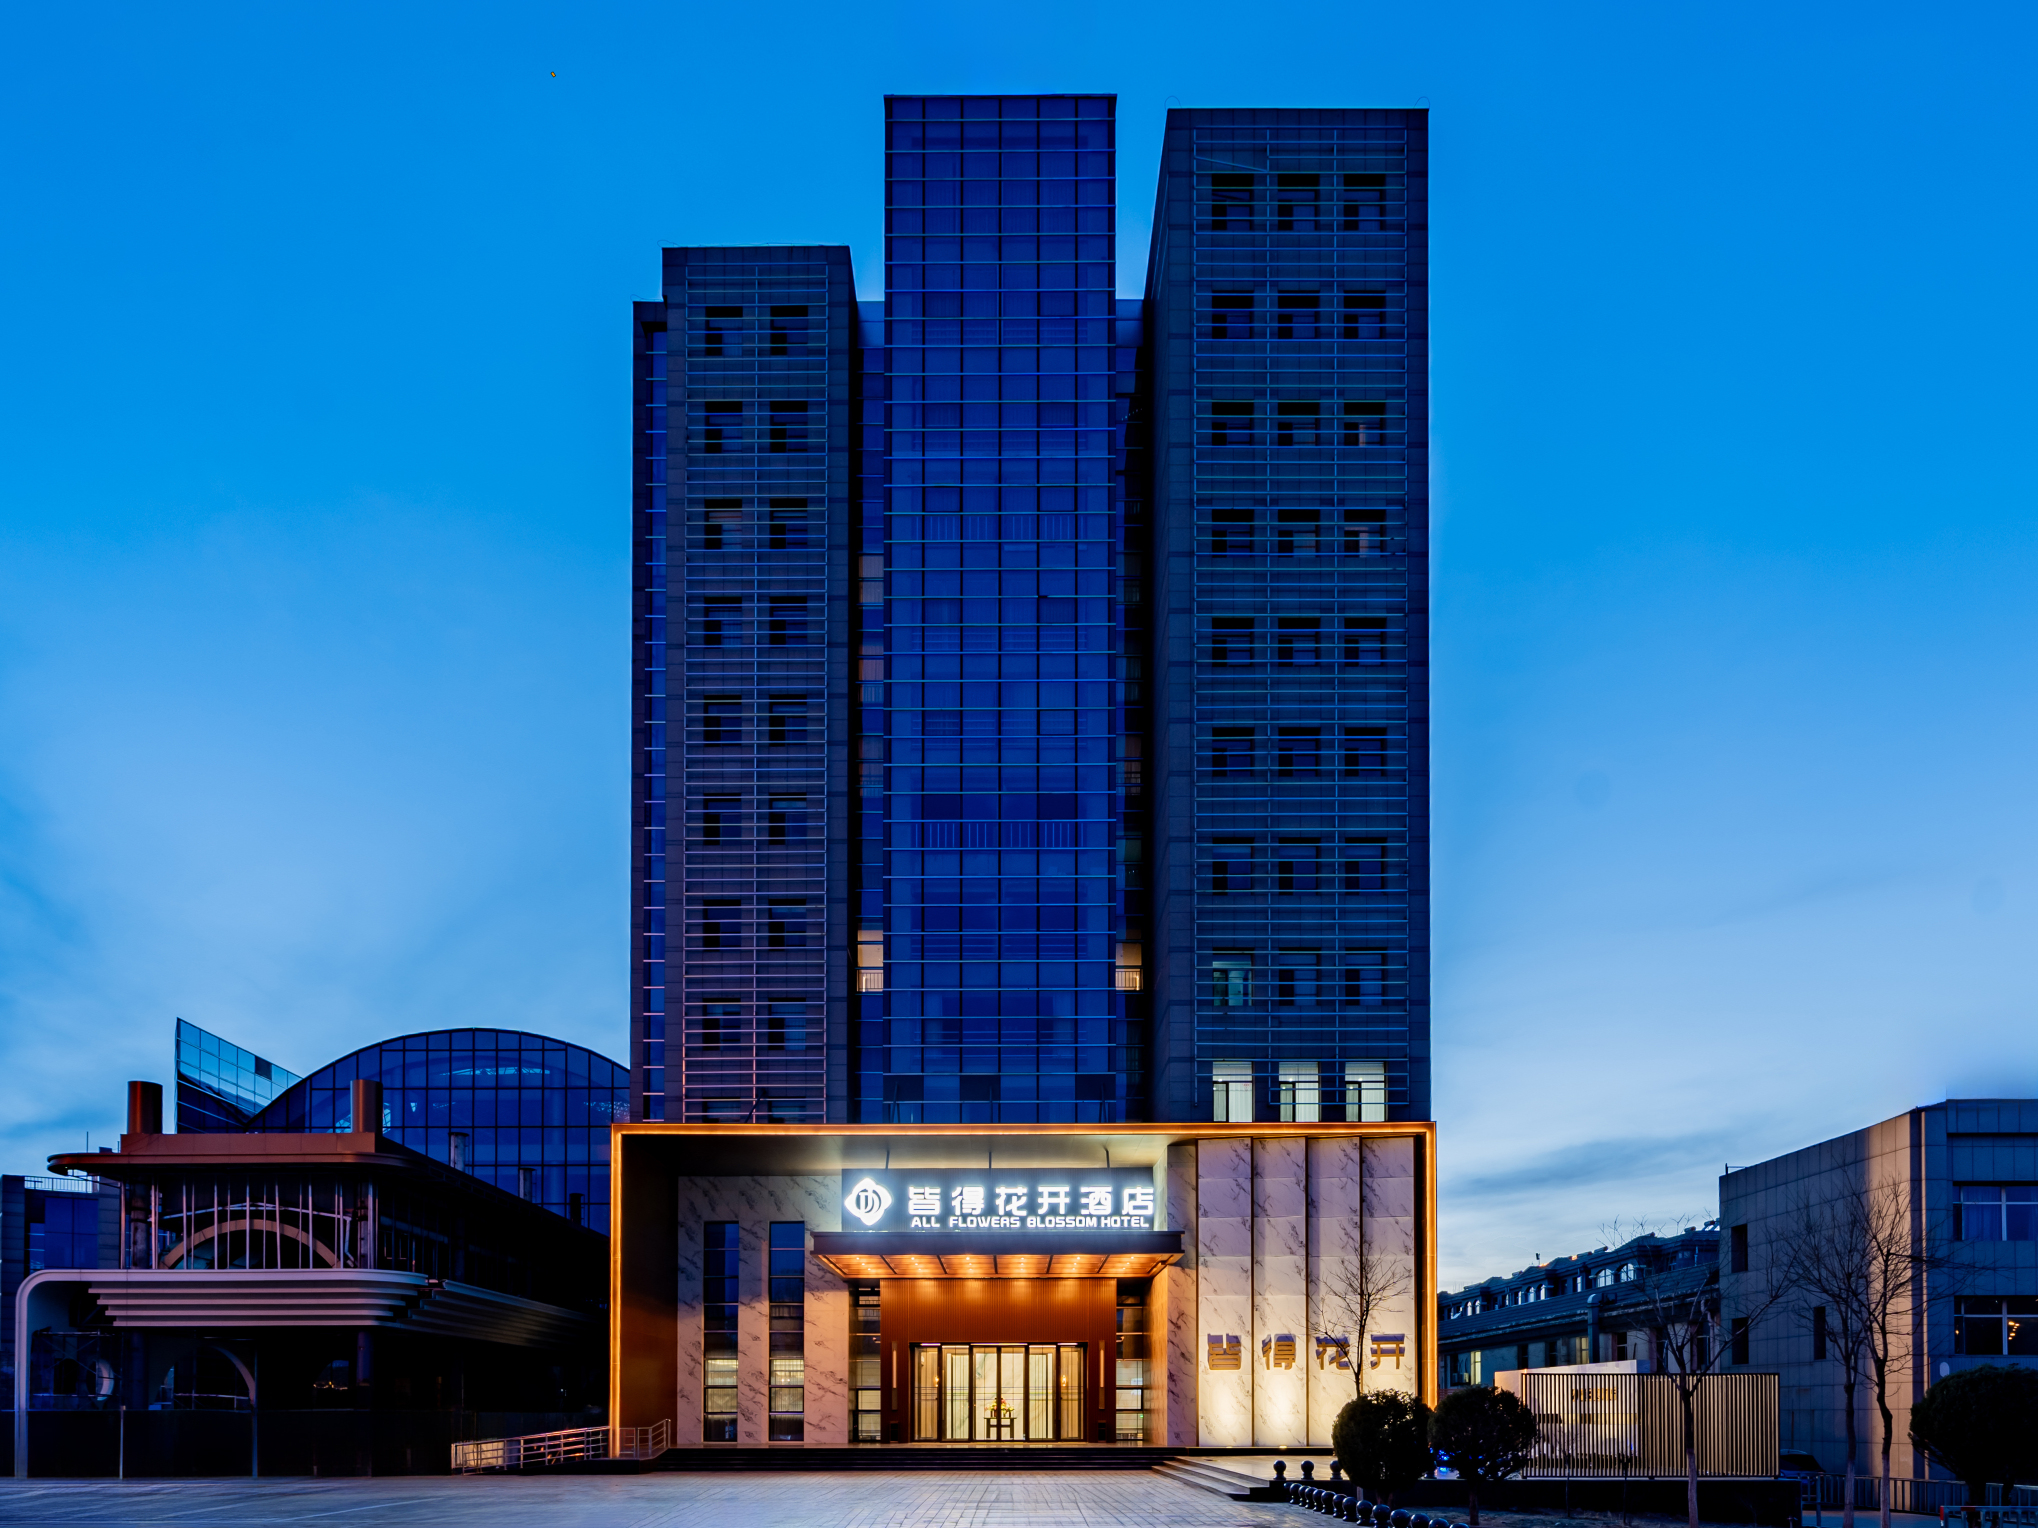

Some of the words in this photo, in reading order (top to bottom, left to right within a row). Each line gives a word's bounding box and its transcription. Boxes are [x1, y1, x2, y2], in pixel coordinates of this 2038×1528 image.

[908, 1186, 1154, 1216] 皆得花开酒店
[911, 1216, 940, 1228] ALL
[949, 1216, 1020, 1228] FLOWERS
[1027, 1216, 1097, 1228] BLOSSOM
[1101, 1216, 1149, 1228] HOTEL
[1207, 1333, 1405, 1370] 皆得花开
